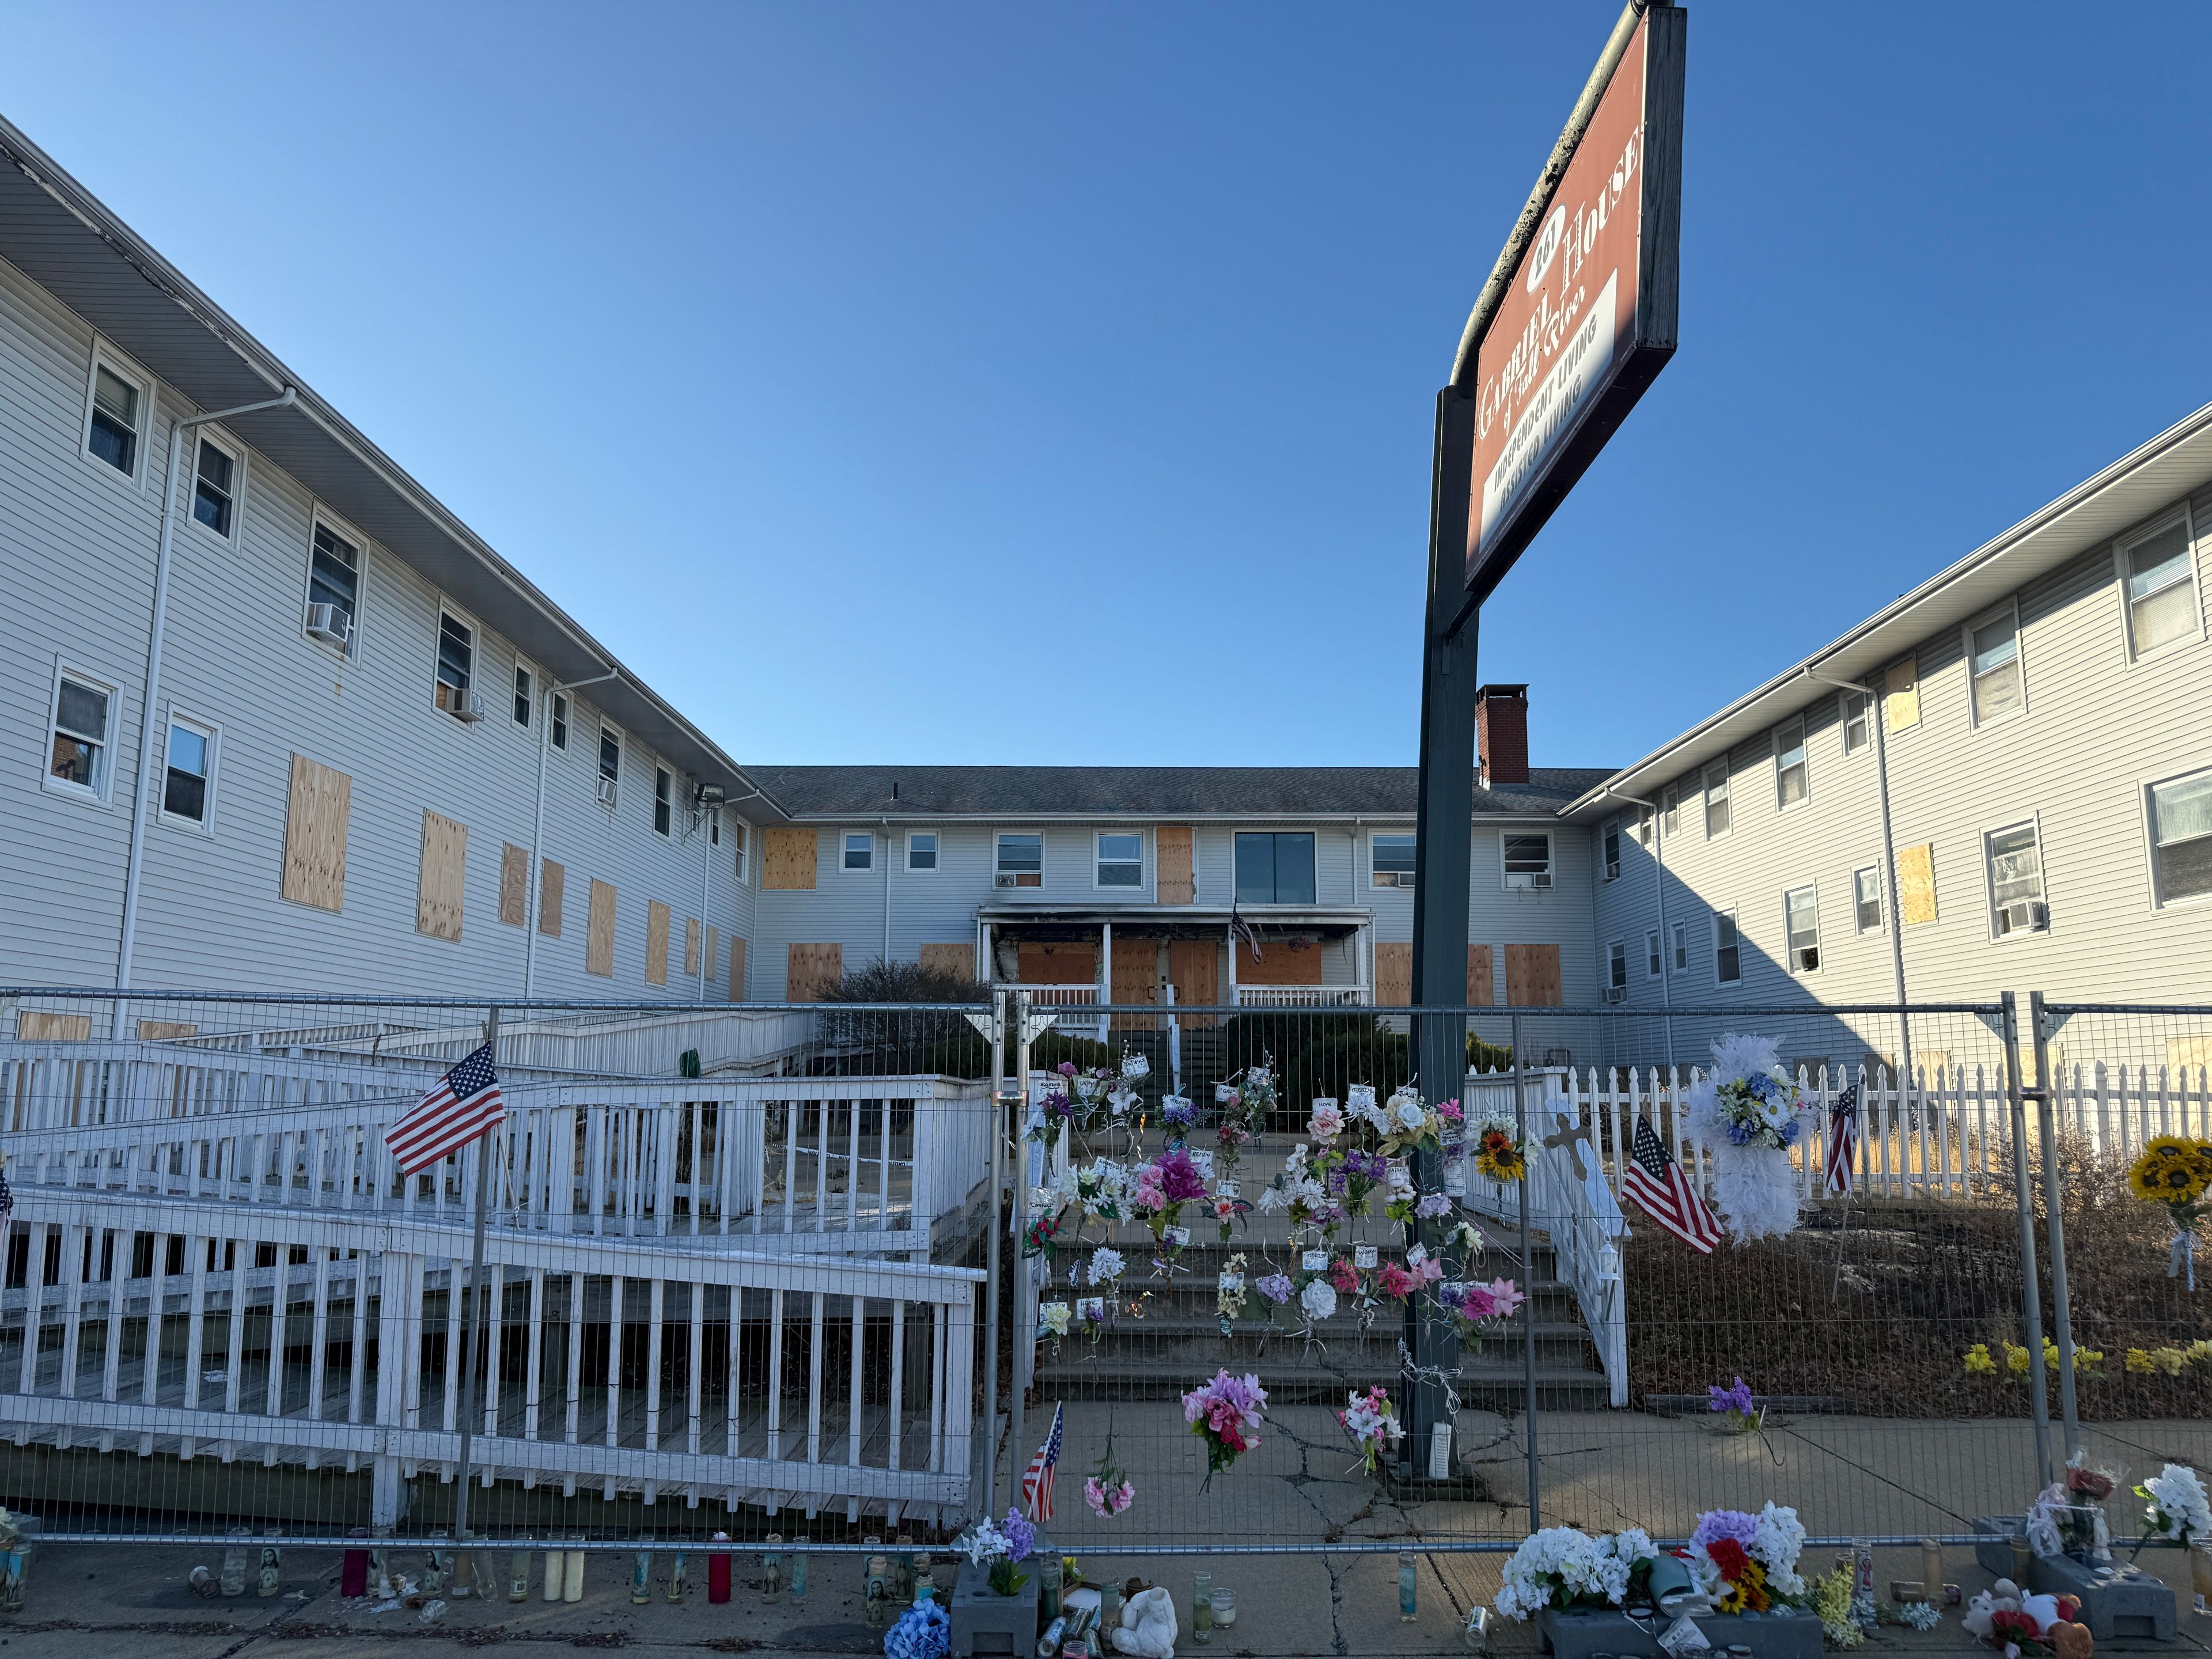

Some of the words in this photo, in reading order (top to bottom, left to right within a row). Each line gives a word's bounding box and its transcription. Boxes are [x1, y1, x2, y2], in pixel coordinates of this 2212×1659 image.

[1478, 289, 1552, 440] GABRIEL
[1560, 125, 1639, 300] HOUSE
[1535, 218, 1556, 281] 261
[1494, 376, 1555, 493] INDEPENDENT
[1558, 313, 1597, 390] LIVING
[1503, 387, 1513, 437] of
[1514, 340, 1539, 406] Fall
[1544, 285, 1585, 357] River
[1499, 434, 1540, 513] ASSISTED
[1543, 373, 1582, 445] LIVING
